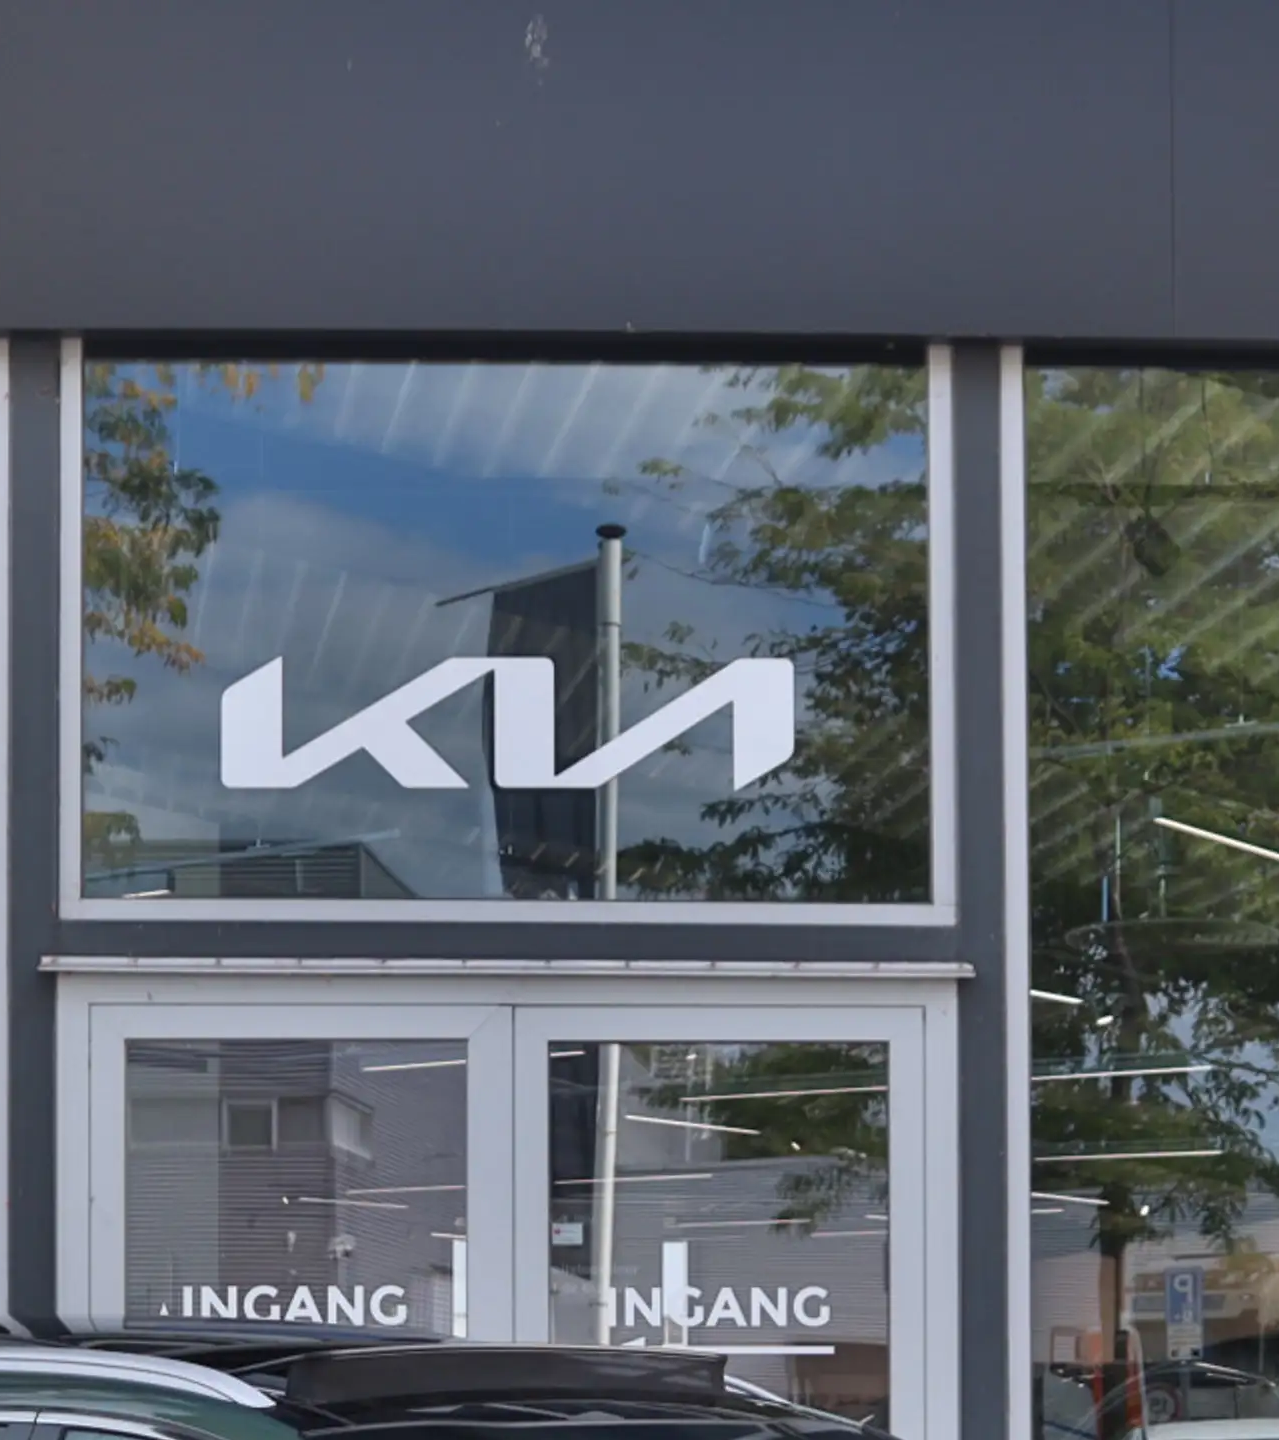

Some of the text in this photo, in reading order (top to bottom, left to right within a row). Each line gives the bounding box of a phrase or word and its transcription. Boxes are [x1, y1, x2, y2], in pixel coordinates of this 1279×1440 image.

[221, 656, 794, 791] KIA
[182, 1285, 408, 1327] INGANG
[606, 1286, 831, 1327] INGANG
